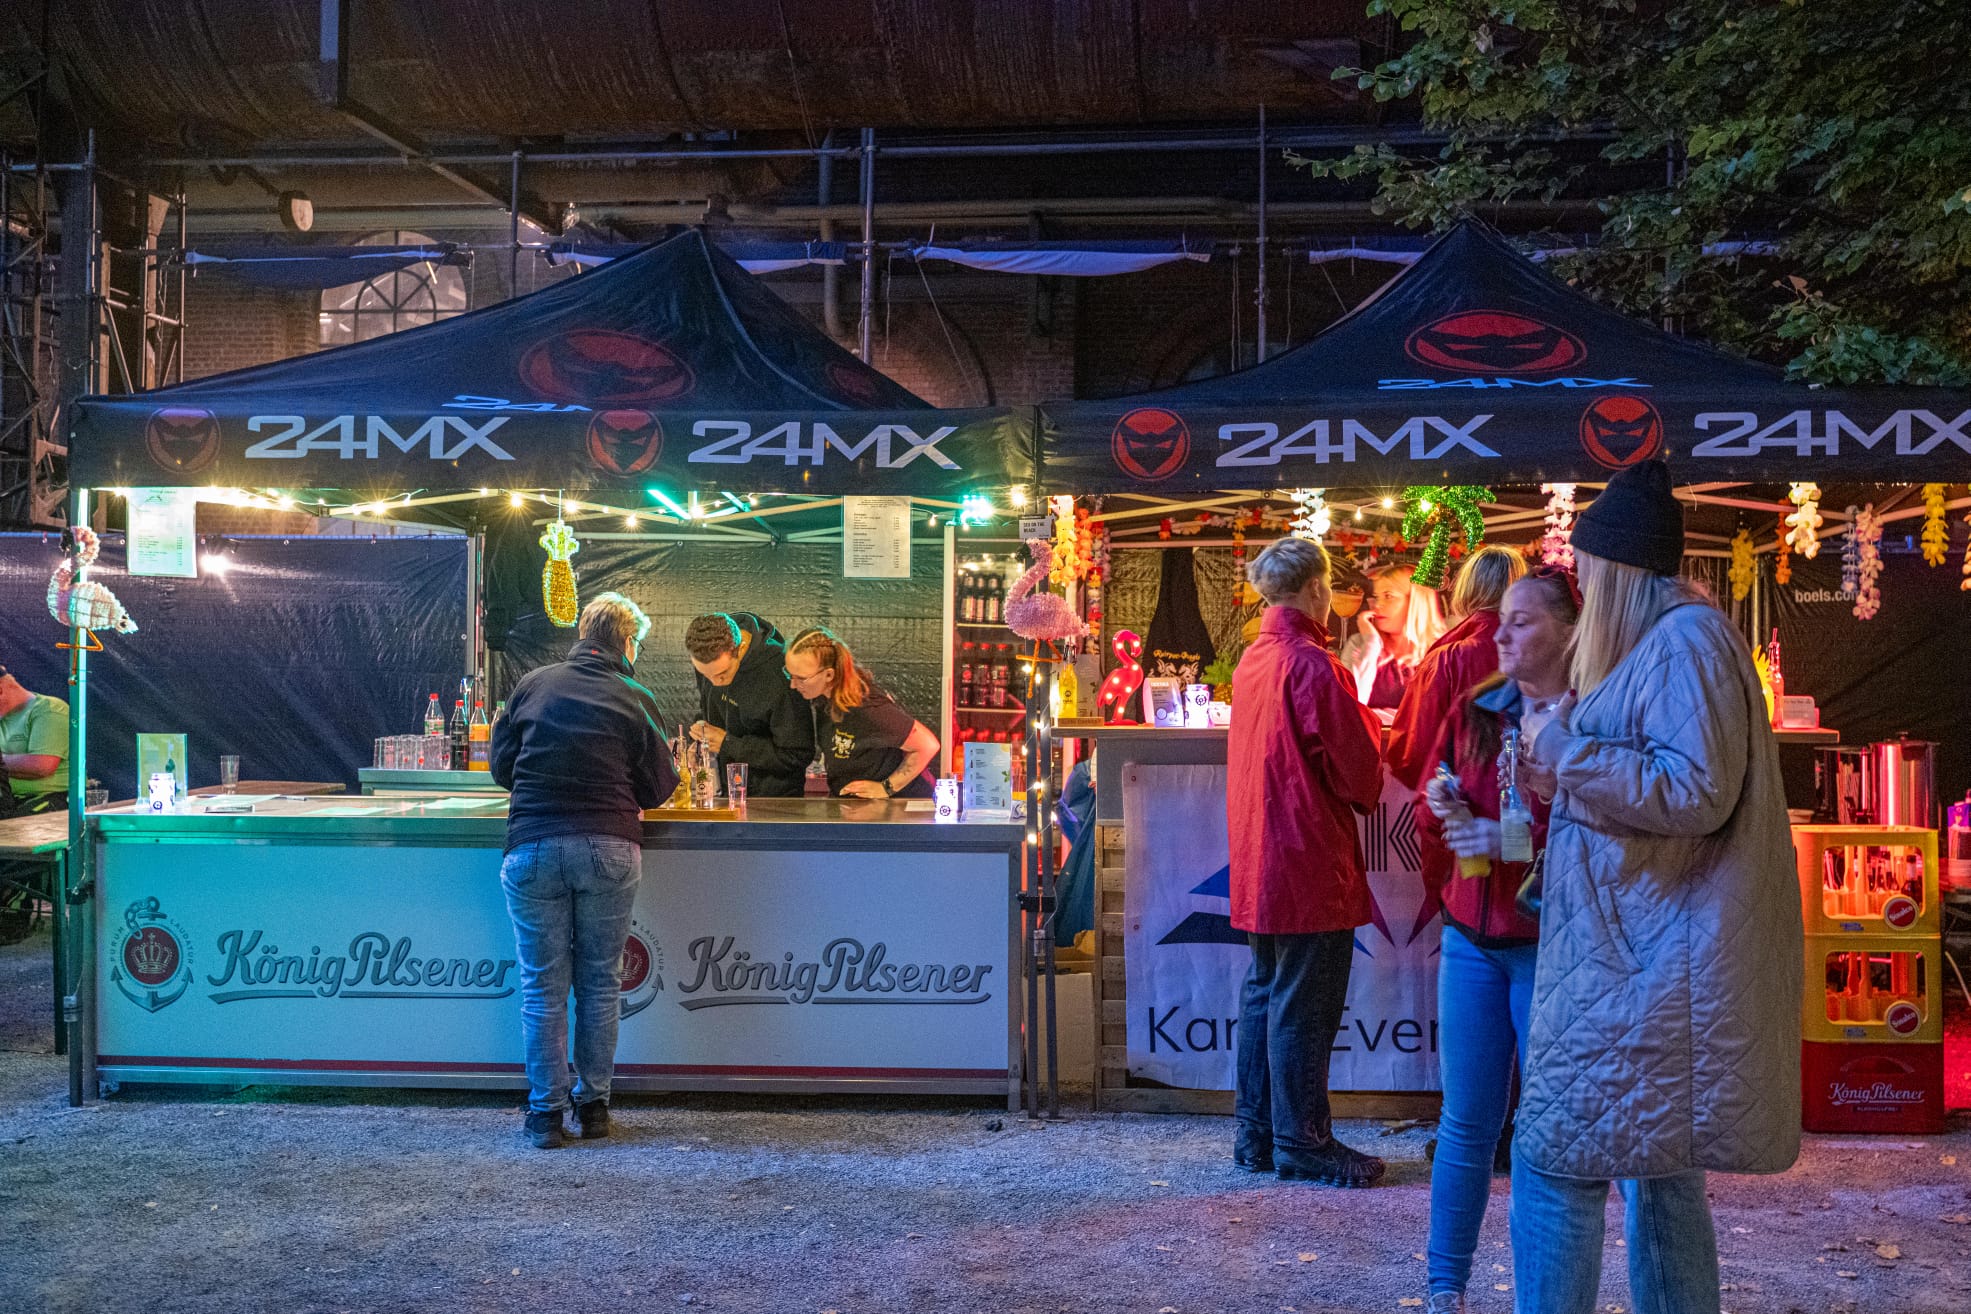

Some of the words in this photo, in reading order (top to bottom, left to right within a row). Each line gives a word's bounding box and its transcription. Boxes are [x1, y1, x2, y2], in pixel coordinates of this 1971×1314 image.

[441, 394, 593, 412] 24
[1377, 377, 1653, 389] 24MX
[245, 415, 516, 460] 24MX
[688, 420, 962, 470] 24MX
[1215, 414, 1502, 467] 24MX
[1691, 409, 1971, 457] 24MX
[110, 925, 127, 963] PURUM
[168, 918, 195, 965] LAUDATUR
[206, 929, 347, 998] König
[343, 931, 516, 988] Pilsener
[639, 924, 665, 971] LAUDATUR
[677, 936, 819, 1005] König
[816, 937, 993, 993] Pilsener
[1828, 1082, 1871, 1103] König
[1870, 1082, 1925, 1100] Pilsener
